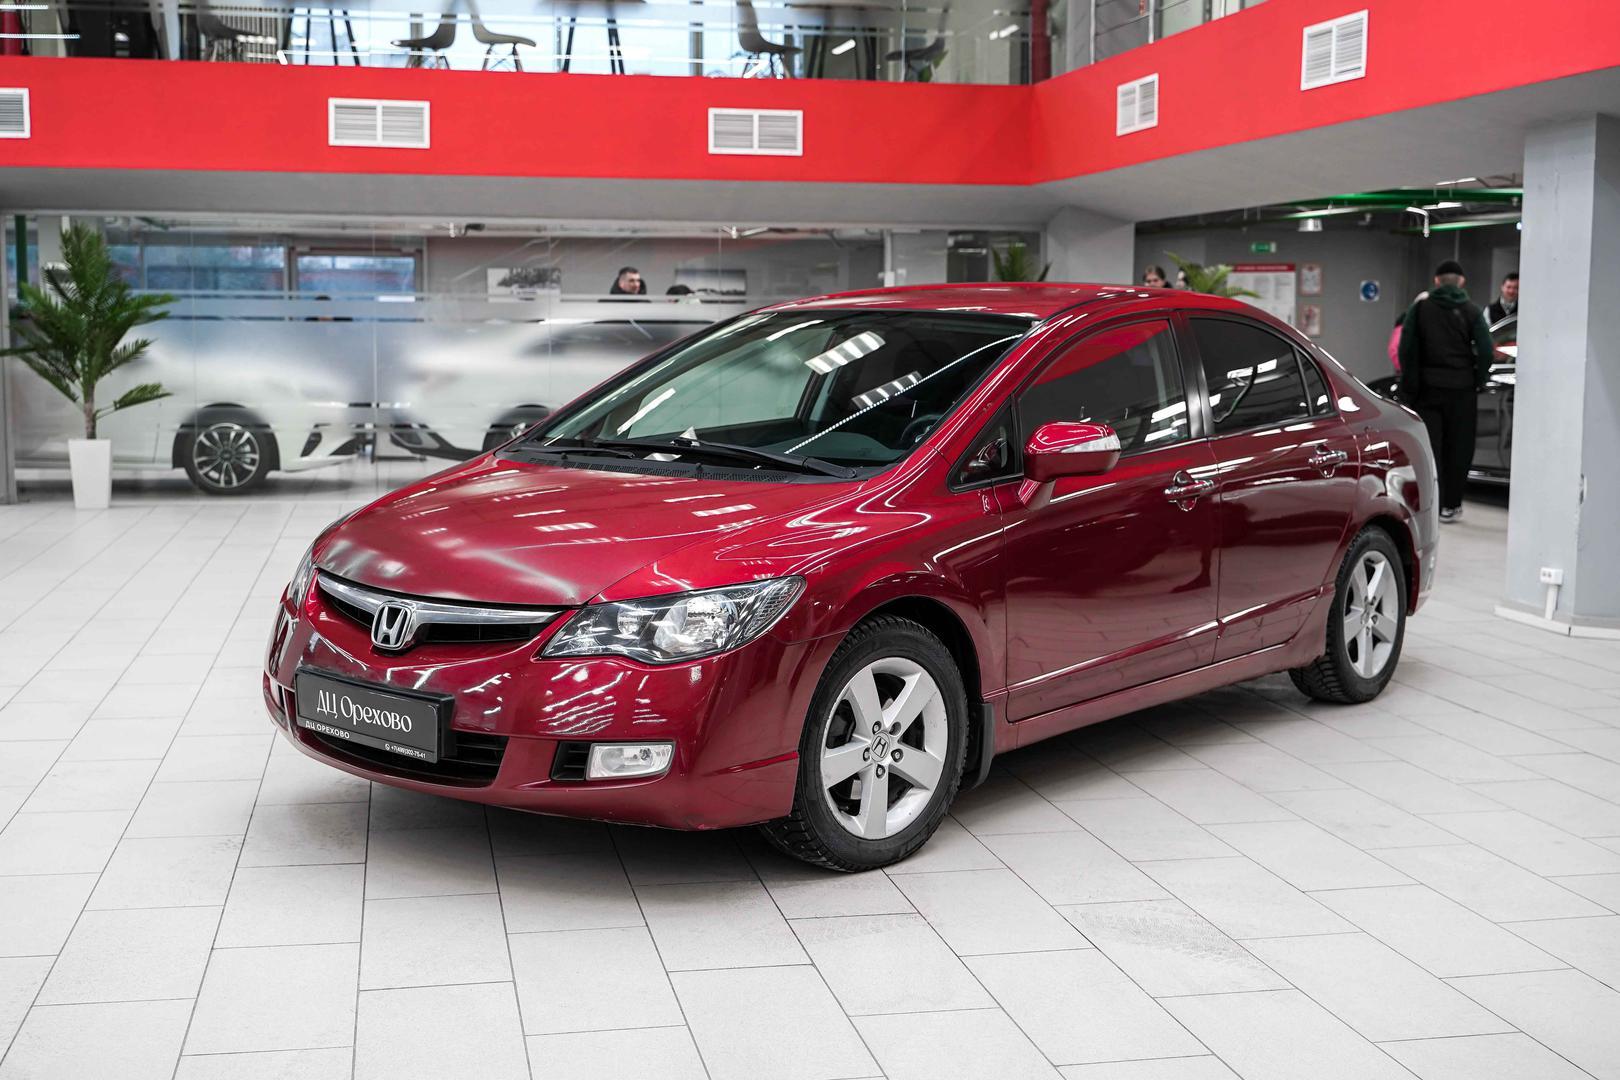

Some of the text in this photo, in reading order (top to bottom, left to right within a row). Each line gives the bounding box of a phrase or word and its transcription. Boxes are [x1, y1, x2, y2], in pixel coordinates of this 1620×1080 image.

[317, 689, 412, 733] ДЦ Орехово
[305, 720, 350, 739] ДЦ ОРЕХОВО
